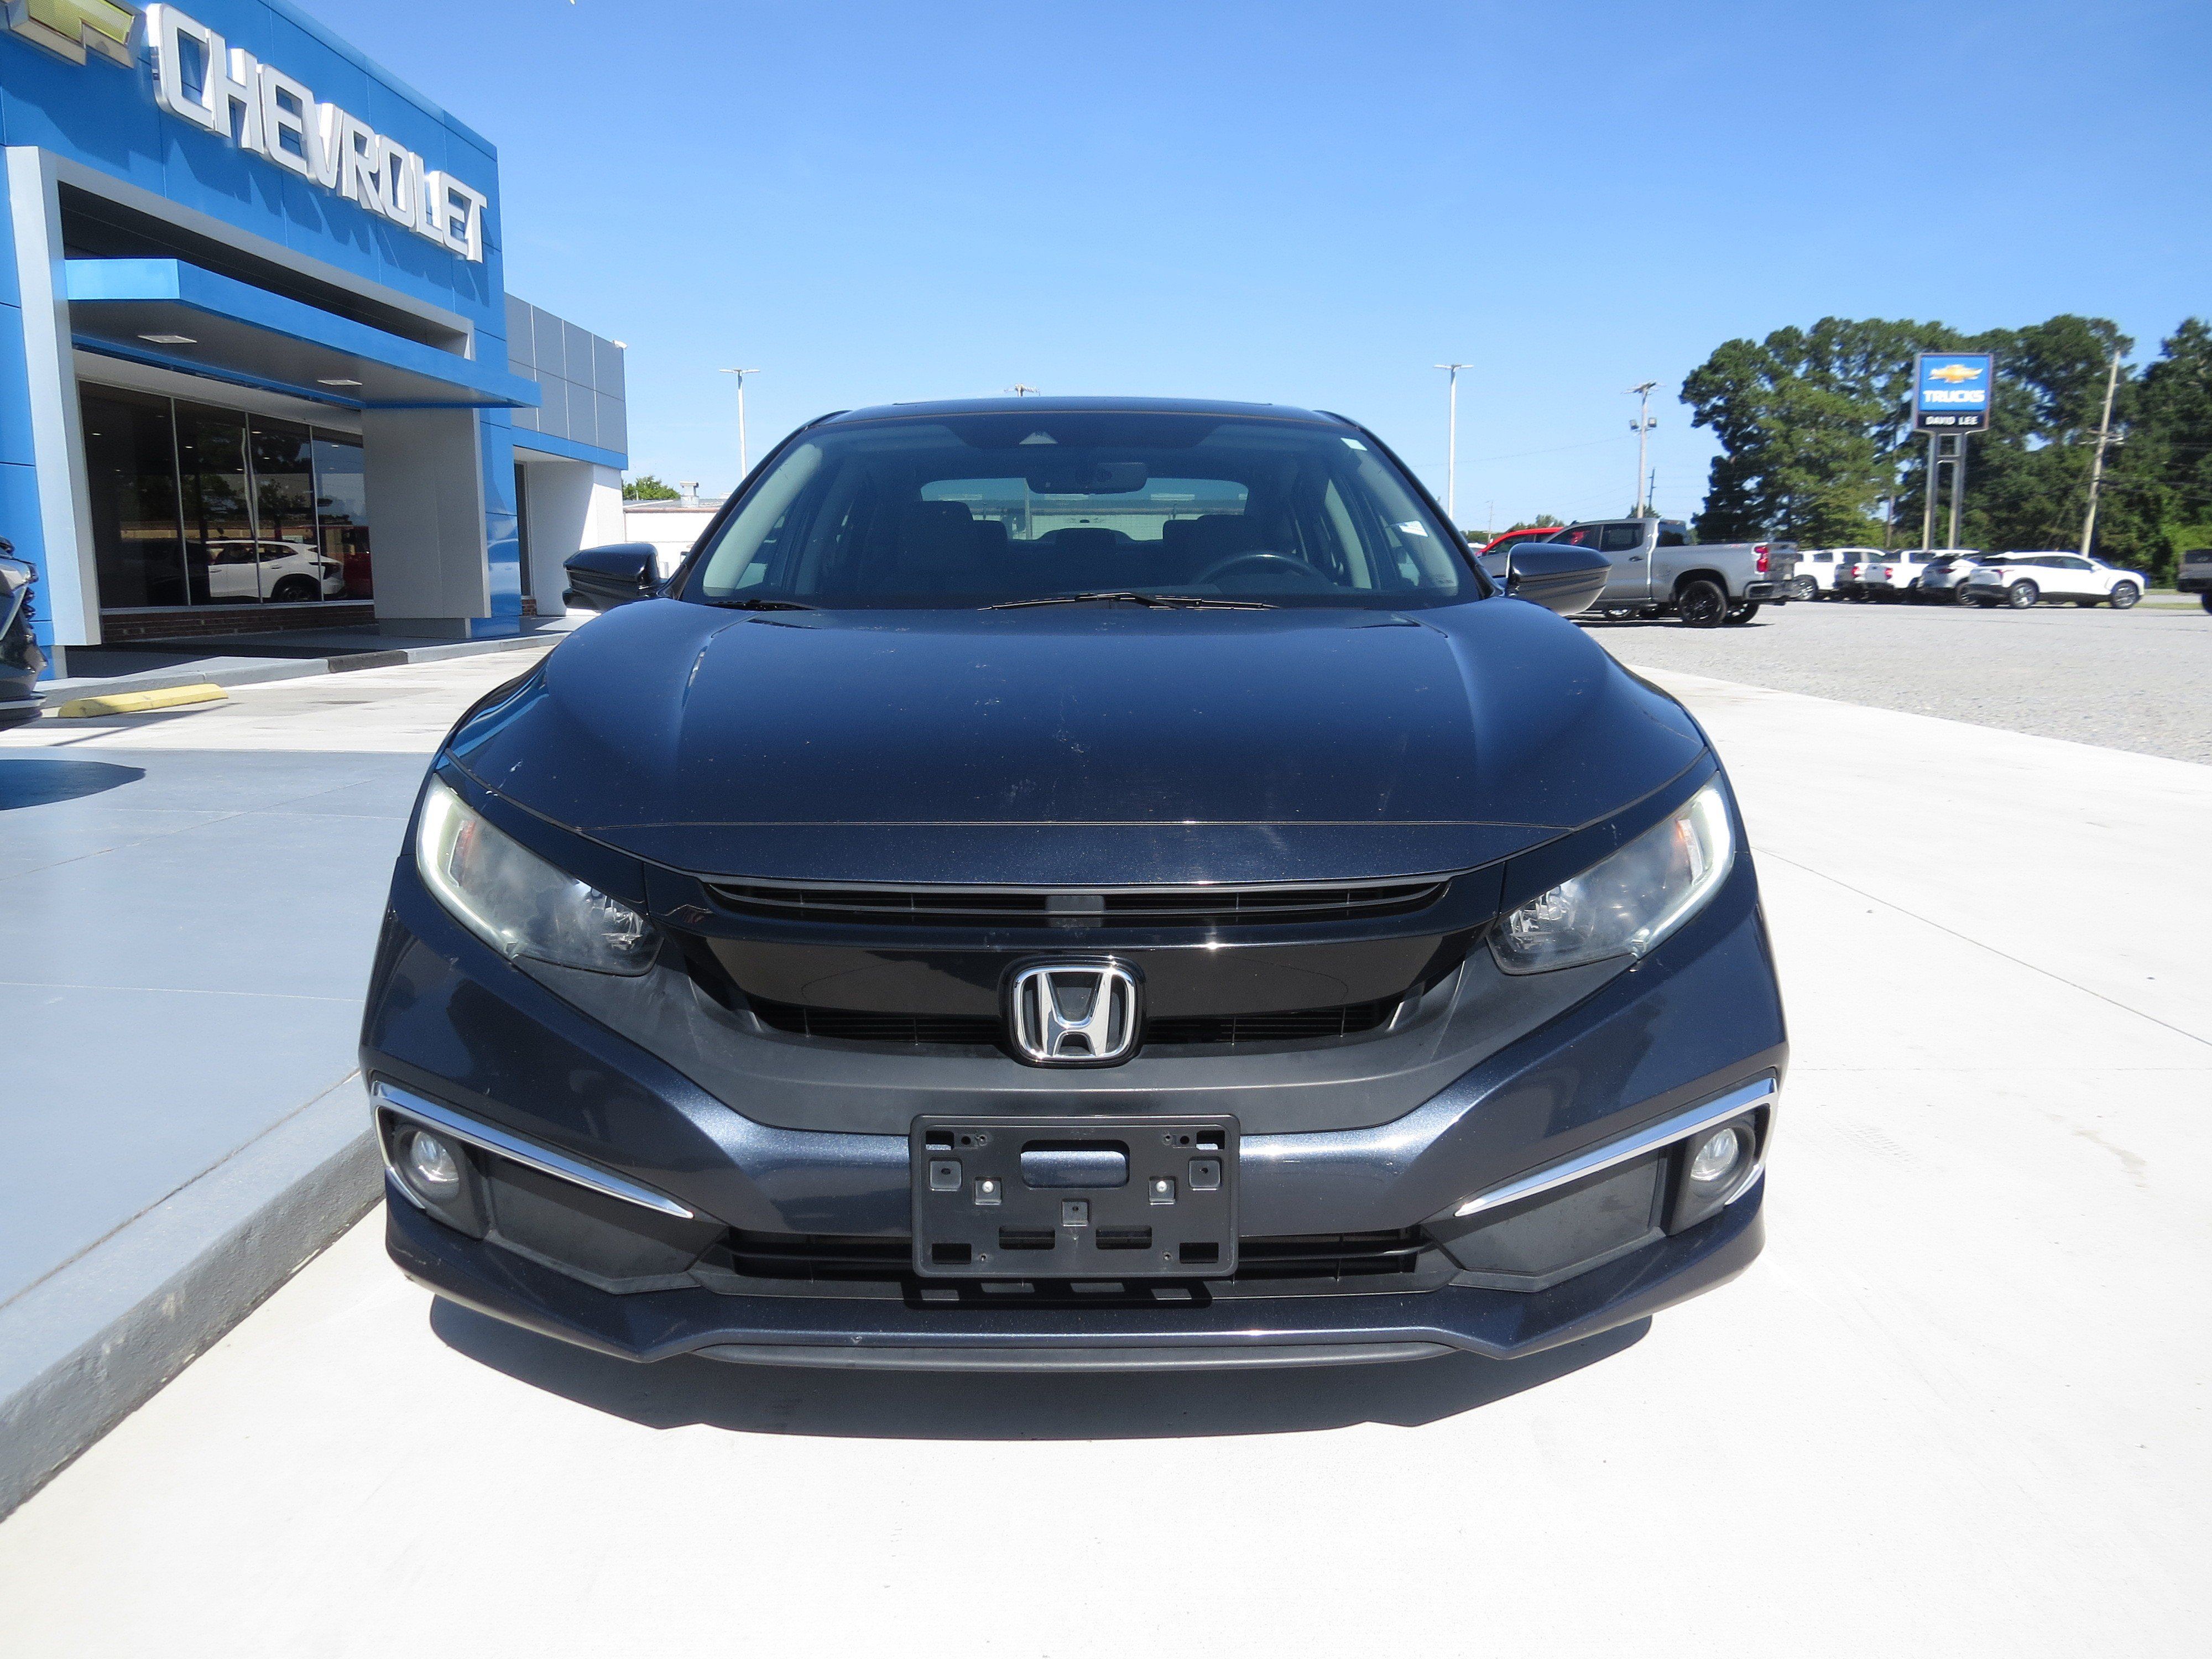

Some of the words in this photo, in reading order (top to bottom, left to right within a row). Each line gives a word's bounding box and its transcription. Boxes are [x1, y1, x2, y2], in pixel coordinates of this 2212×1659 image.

[146, 3, 488, 264] CHEVROLET
[1923, 390, 1985, 403] TRUCKS
[1926, 416, 1956, 425] DAVID
[1958, 416, 1978, 425] LEE
